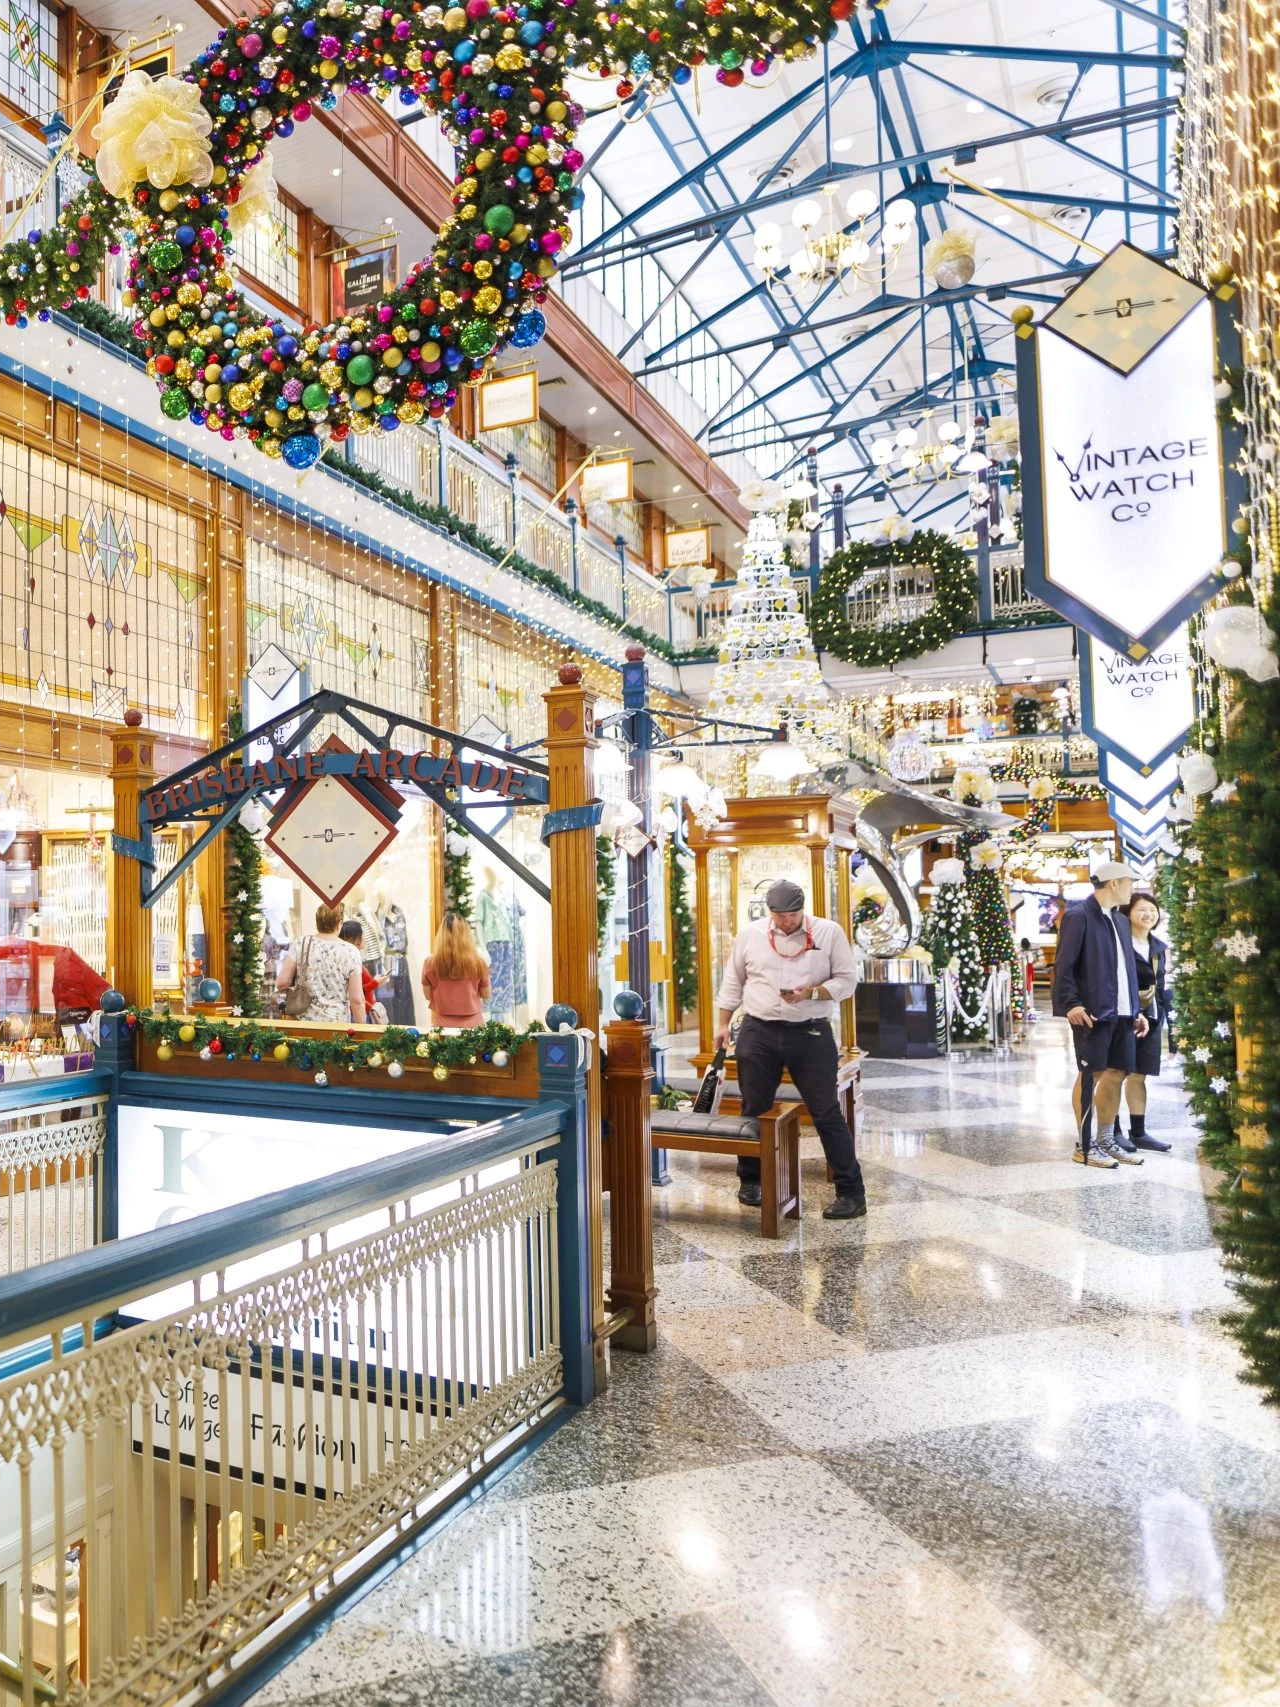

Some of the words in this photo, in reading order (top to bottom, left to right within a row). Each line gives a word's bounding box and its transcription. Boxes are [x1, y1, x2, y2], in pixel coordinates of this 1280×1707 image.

[347, 273, 381, 289] GALLERIES
[1052, 431, 1209, 482] VINTAGE
[1069, 469, 1195, 502] WATCH
[1099, 651, 1185, 674] VINAGE
[1107, 669, 1179, 685] WATCH
[144, 751, 327, 820] BRISBANE
[351, 748, 529, 800] ARCADE
